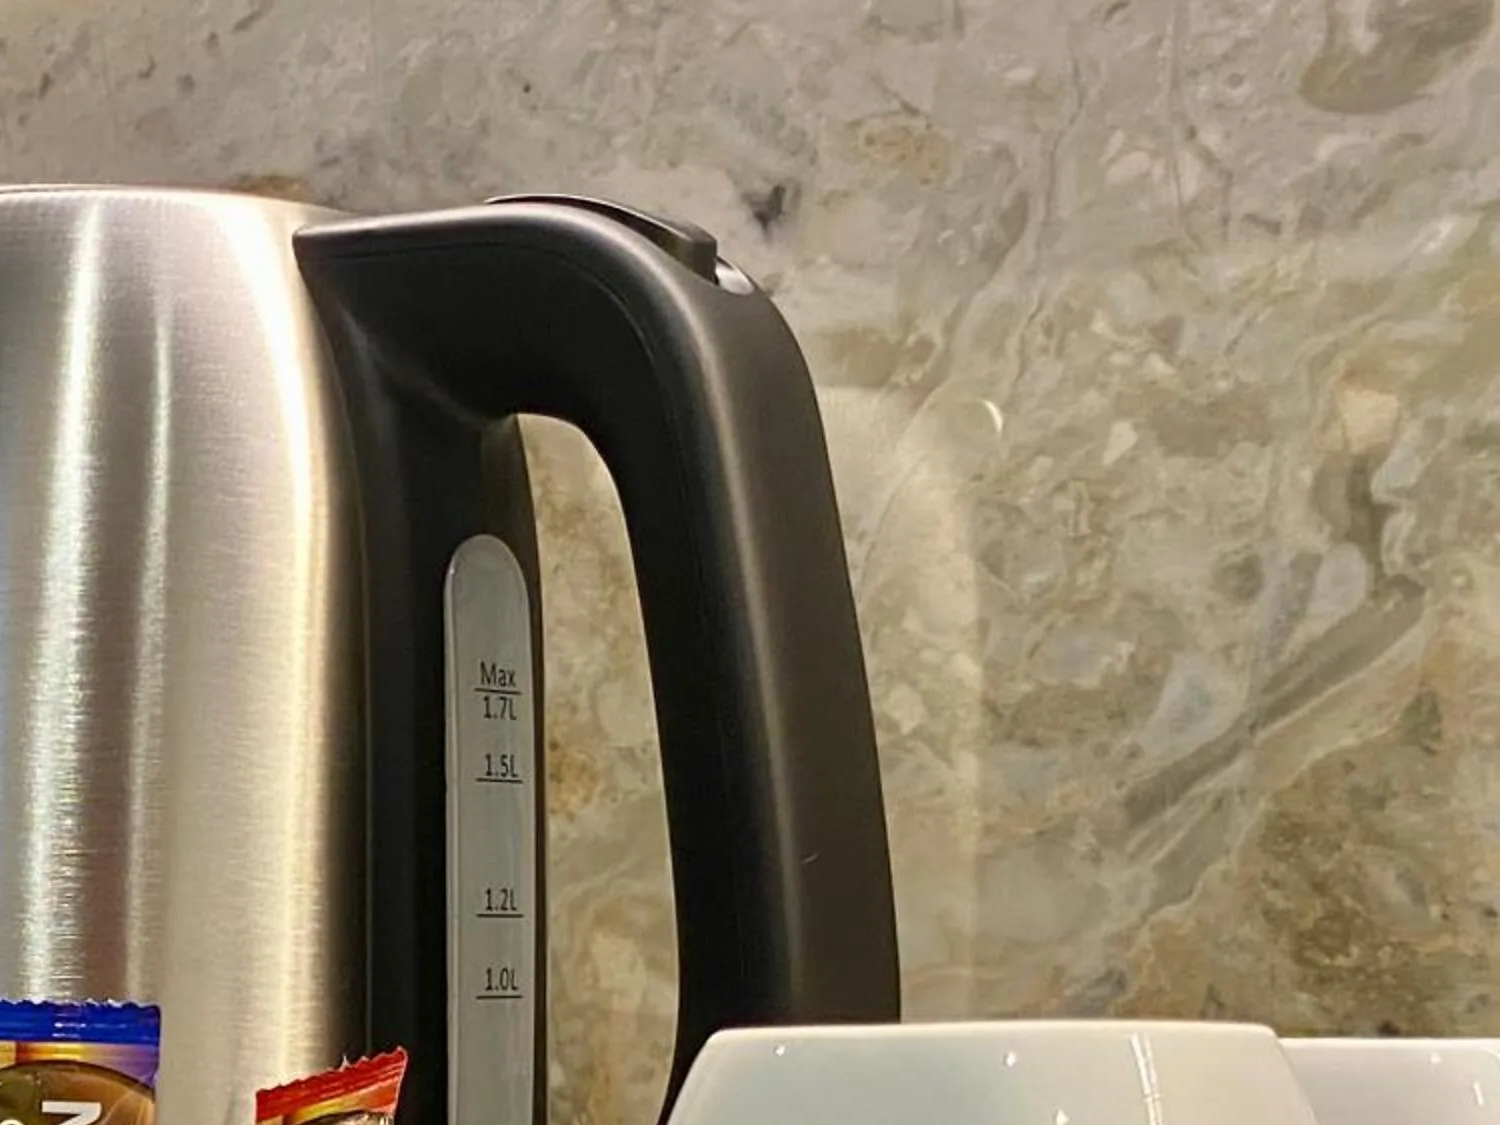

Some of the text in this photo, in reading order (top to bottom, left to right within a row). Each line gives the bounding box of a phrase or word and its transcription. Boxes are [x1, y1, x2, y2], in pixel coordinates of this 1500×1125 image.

[480, 661, 516, 688] Max
[483, 695, 517, 720] 1.7L
[484, 752, 519, 778] 1.5L
[485, 887, 517, 912] 1.2L
[485, 966, 519, 991] 1.0L
